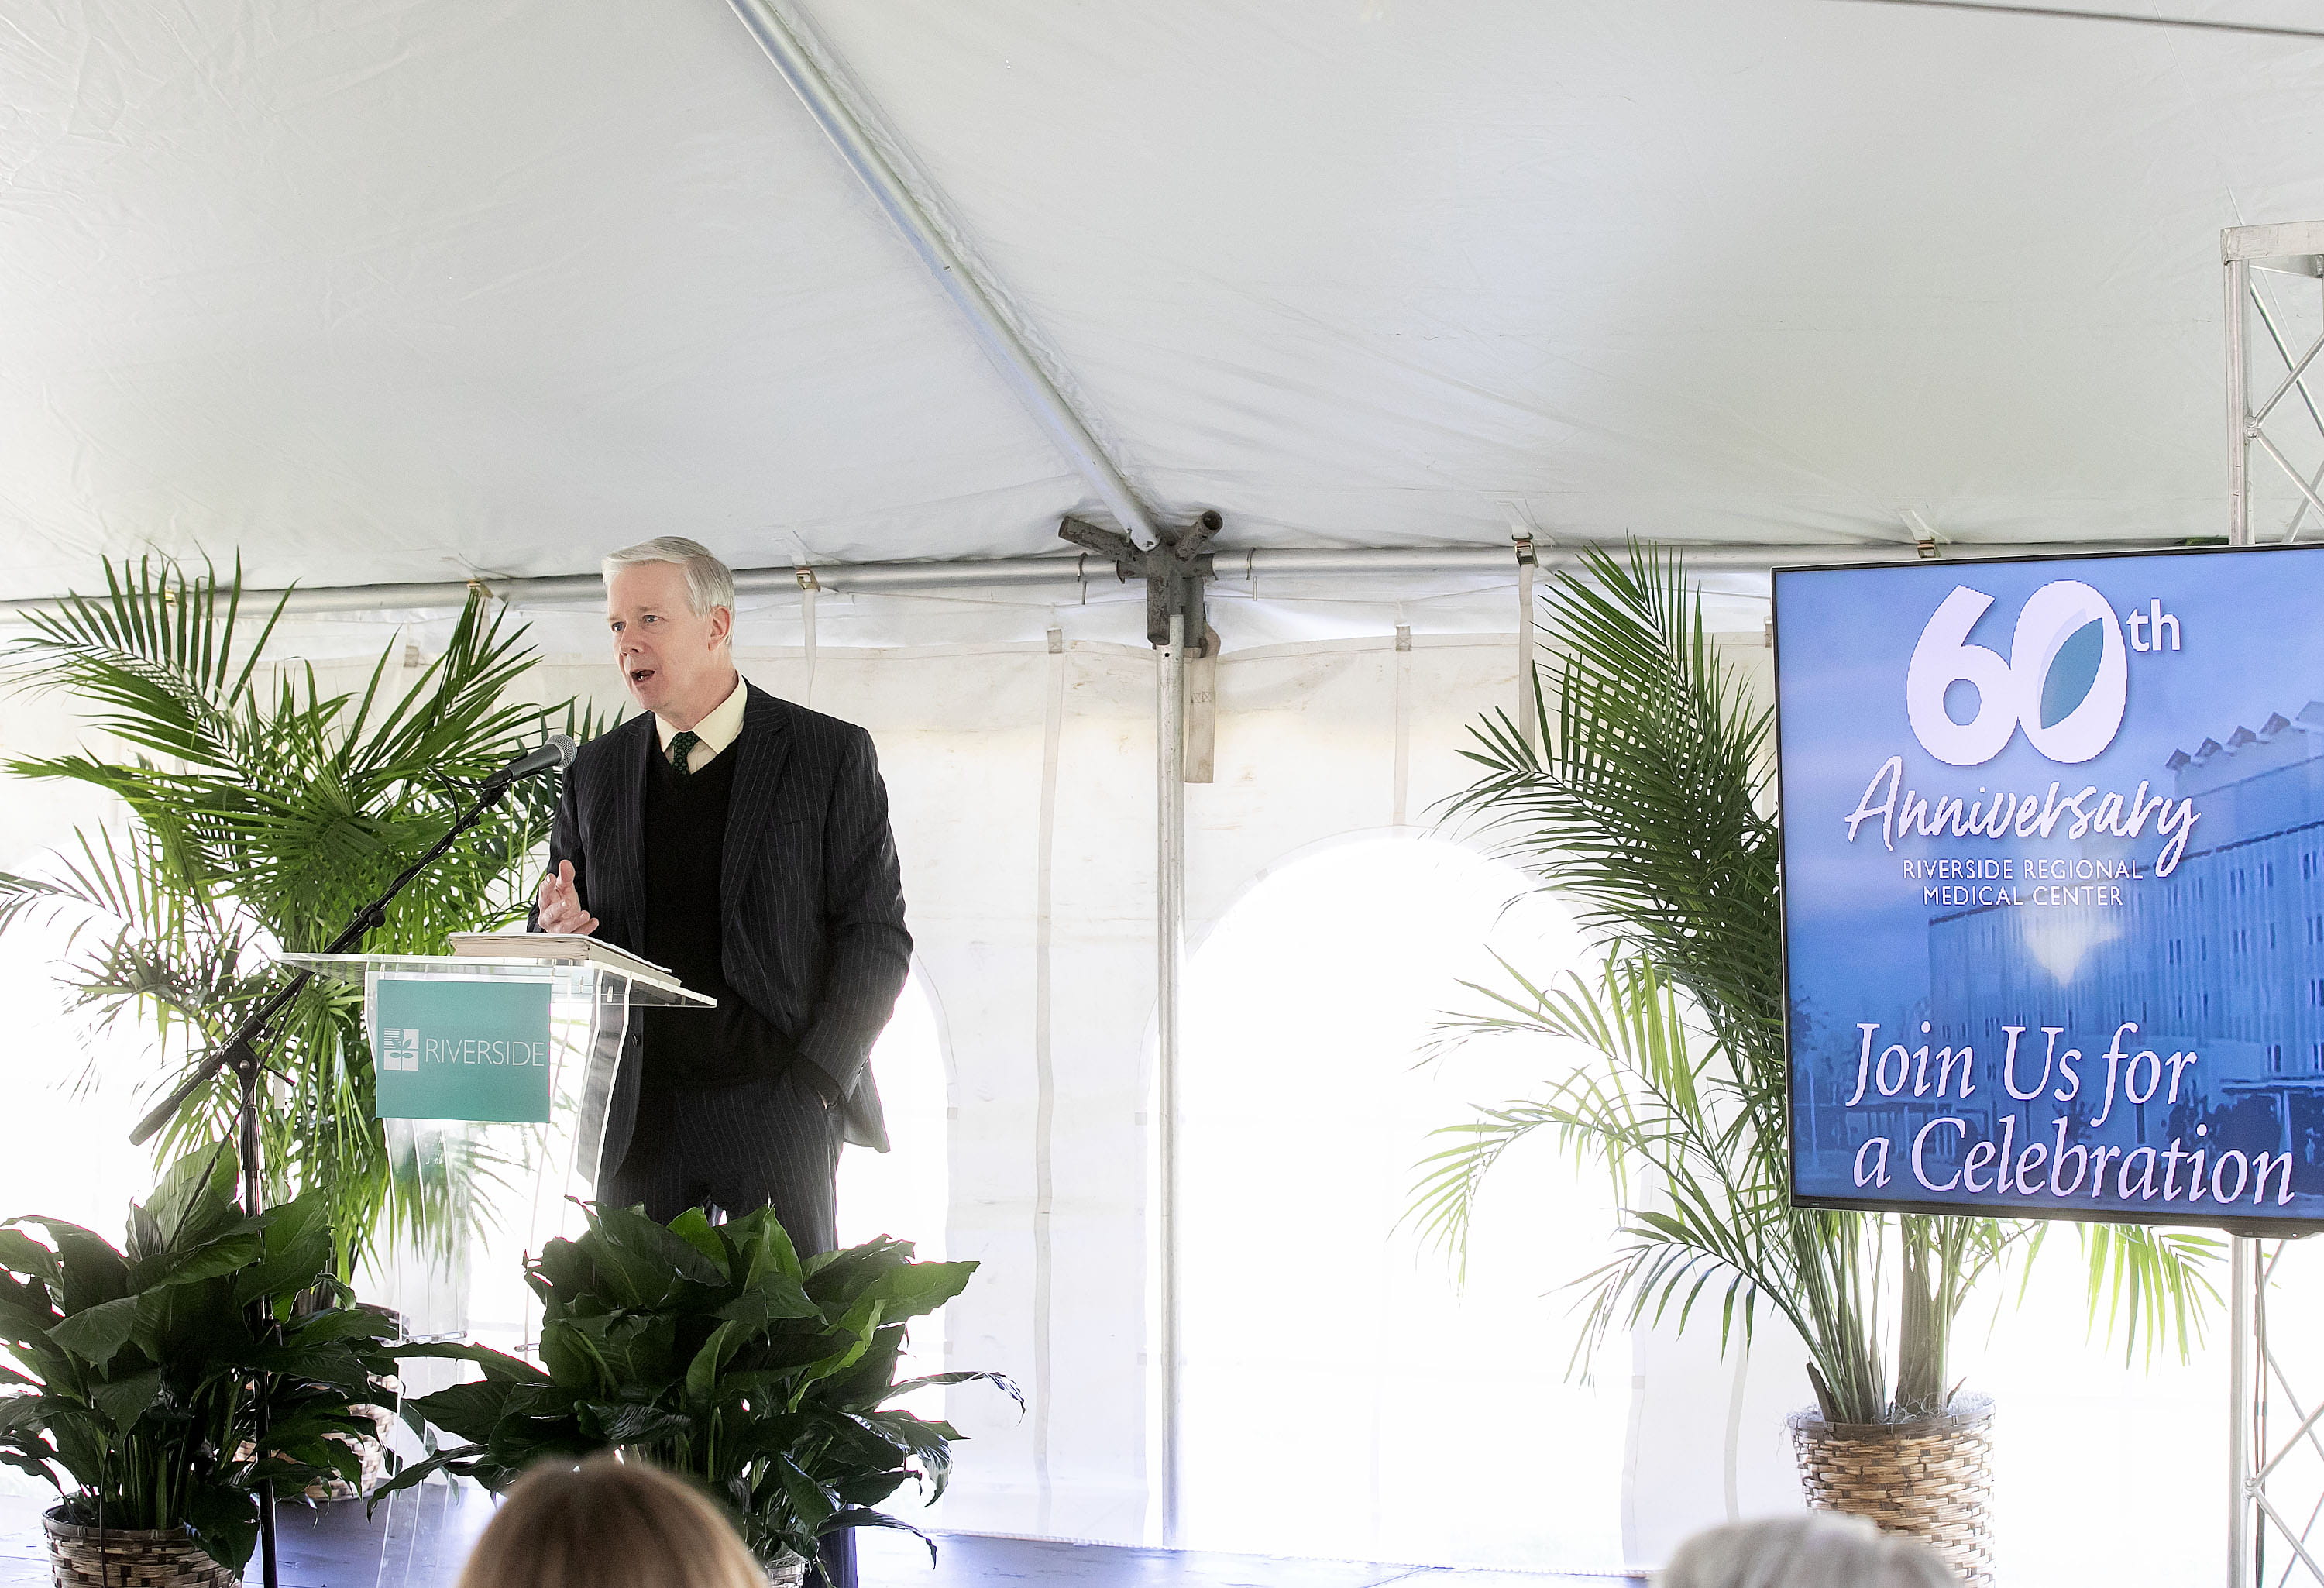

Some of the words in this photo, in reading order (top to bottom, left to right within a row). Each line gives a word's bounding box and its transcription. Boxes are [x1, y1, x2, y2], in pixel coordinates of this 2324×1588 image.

[1844, 755, 2200, 877] Anniversary
[1903, 859, 2014, 880] RIVERSIDE
[2023, 859, 2144, 880] REGIONAL
[1923, 886, 2023, 906] MEDICAL
[2032, 886, 2123, 906] CENTER
[425, 1039, 545, 1067] RIVERSIDE
[1846, 1021, 1975, 1107] Join
[2001, 1026, 2082, 1102] Us
[2091, 1022, 2198, 1127] for
[1852, 1136, 1891, 1189] a
[1910, 1114, 2295, 1207] Celebration
